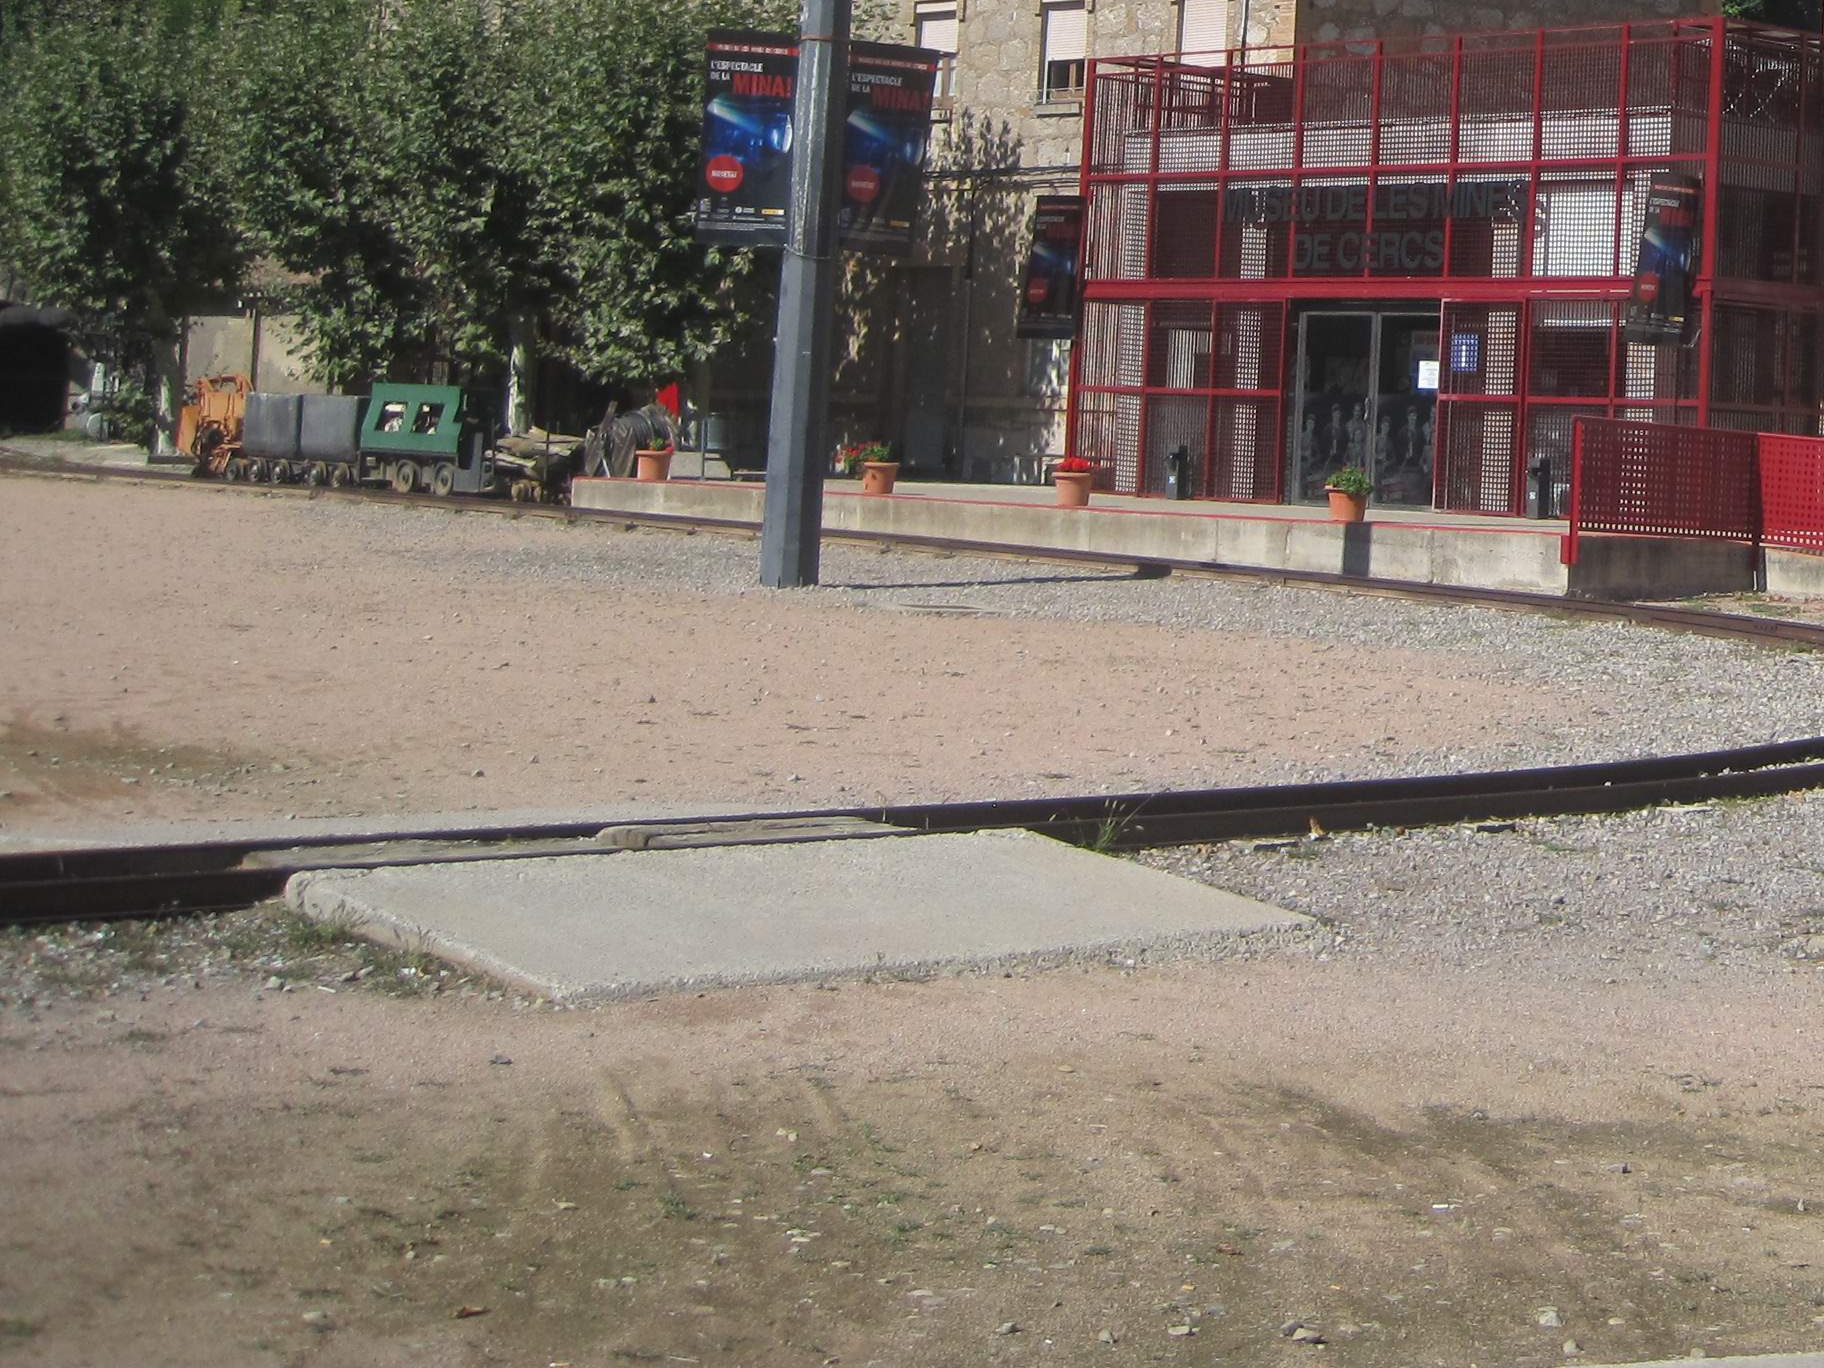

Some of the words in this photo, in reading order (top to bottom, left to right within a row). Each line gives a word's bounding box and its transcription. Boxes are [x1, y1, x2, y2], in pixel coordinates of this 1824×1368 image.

[732, 73, 792, 97] MINA!
[1223, 188, 1321, 222] MUSEU
[1327, 186, 1368, 220] DE
[1375, 184, 1430, 220] LES
[1293, 233, 1332, 269] DE
[1337, 230, 1444, 269] CERCS
